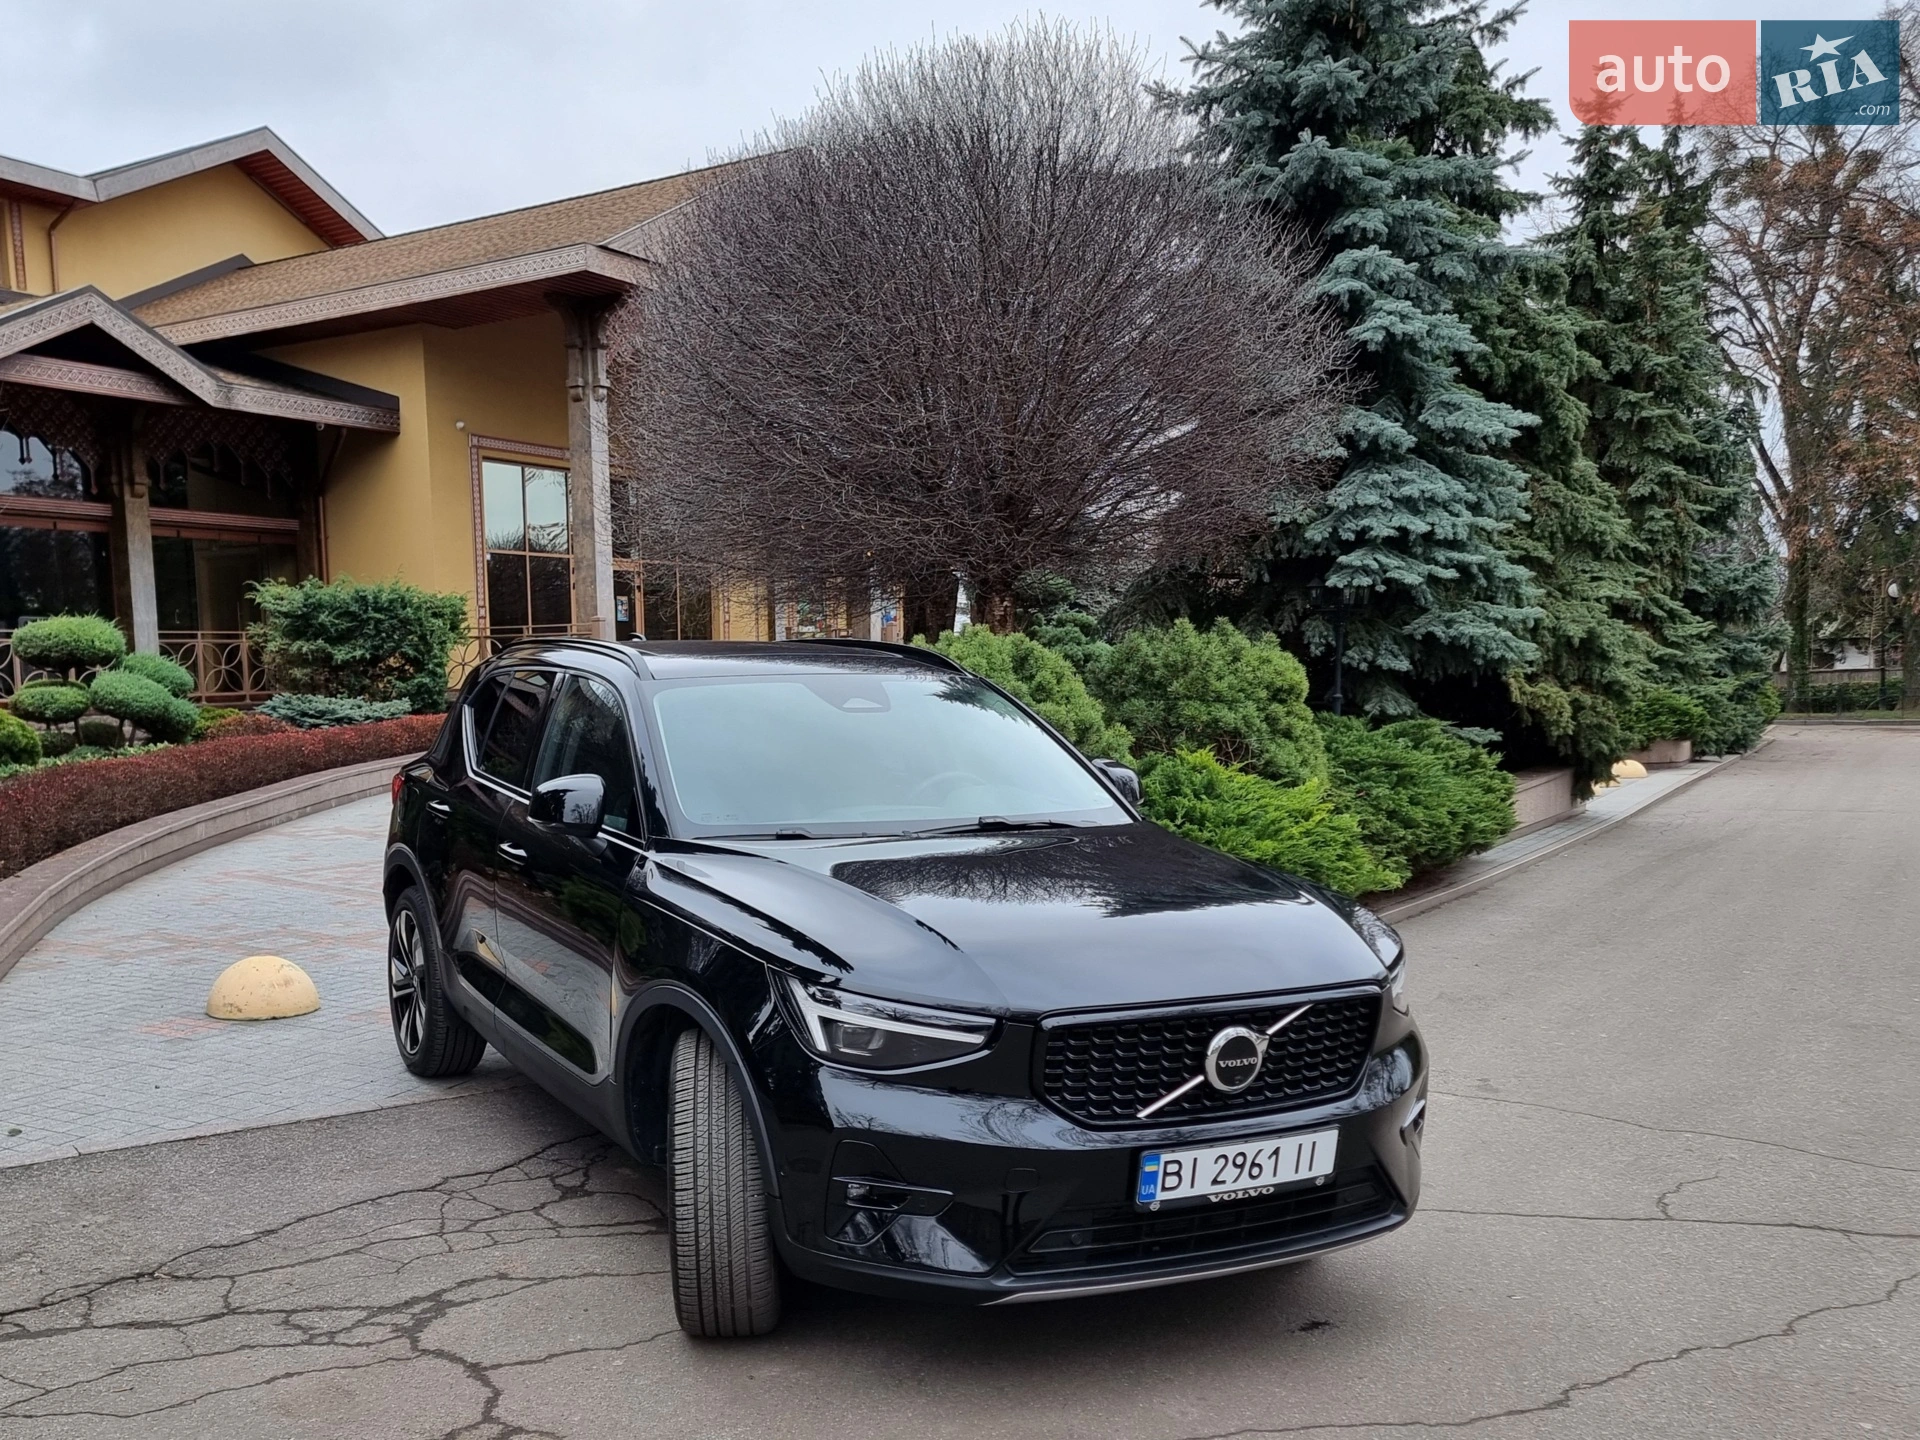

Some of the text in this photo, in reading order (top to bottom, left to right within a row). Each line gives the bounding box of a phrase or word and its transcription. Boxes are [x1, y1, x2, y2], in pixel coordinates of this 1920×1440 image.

[1218, 1057, 1258, 1068] VOLVO
[1160, 1140, 1317, 1193] BI 2961 II
[1141, 1183, 1156, 1196] UA
[1207, 1186, 1275, 1203] VOLVO
